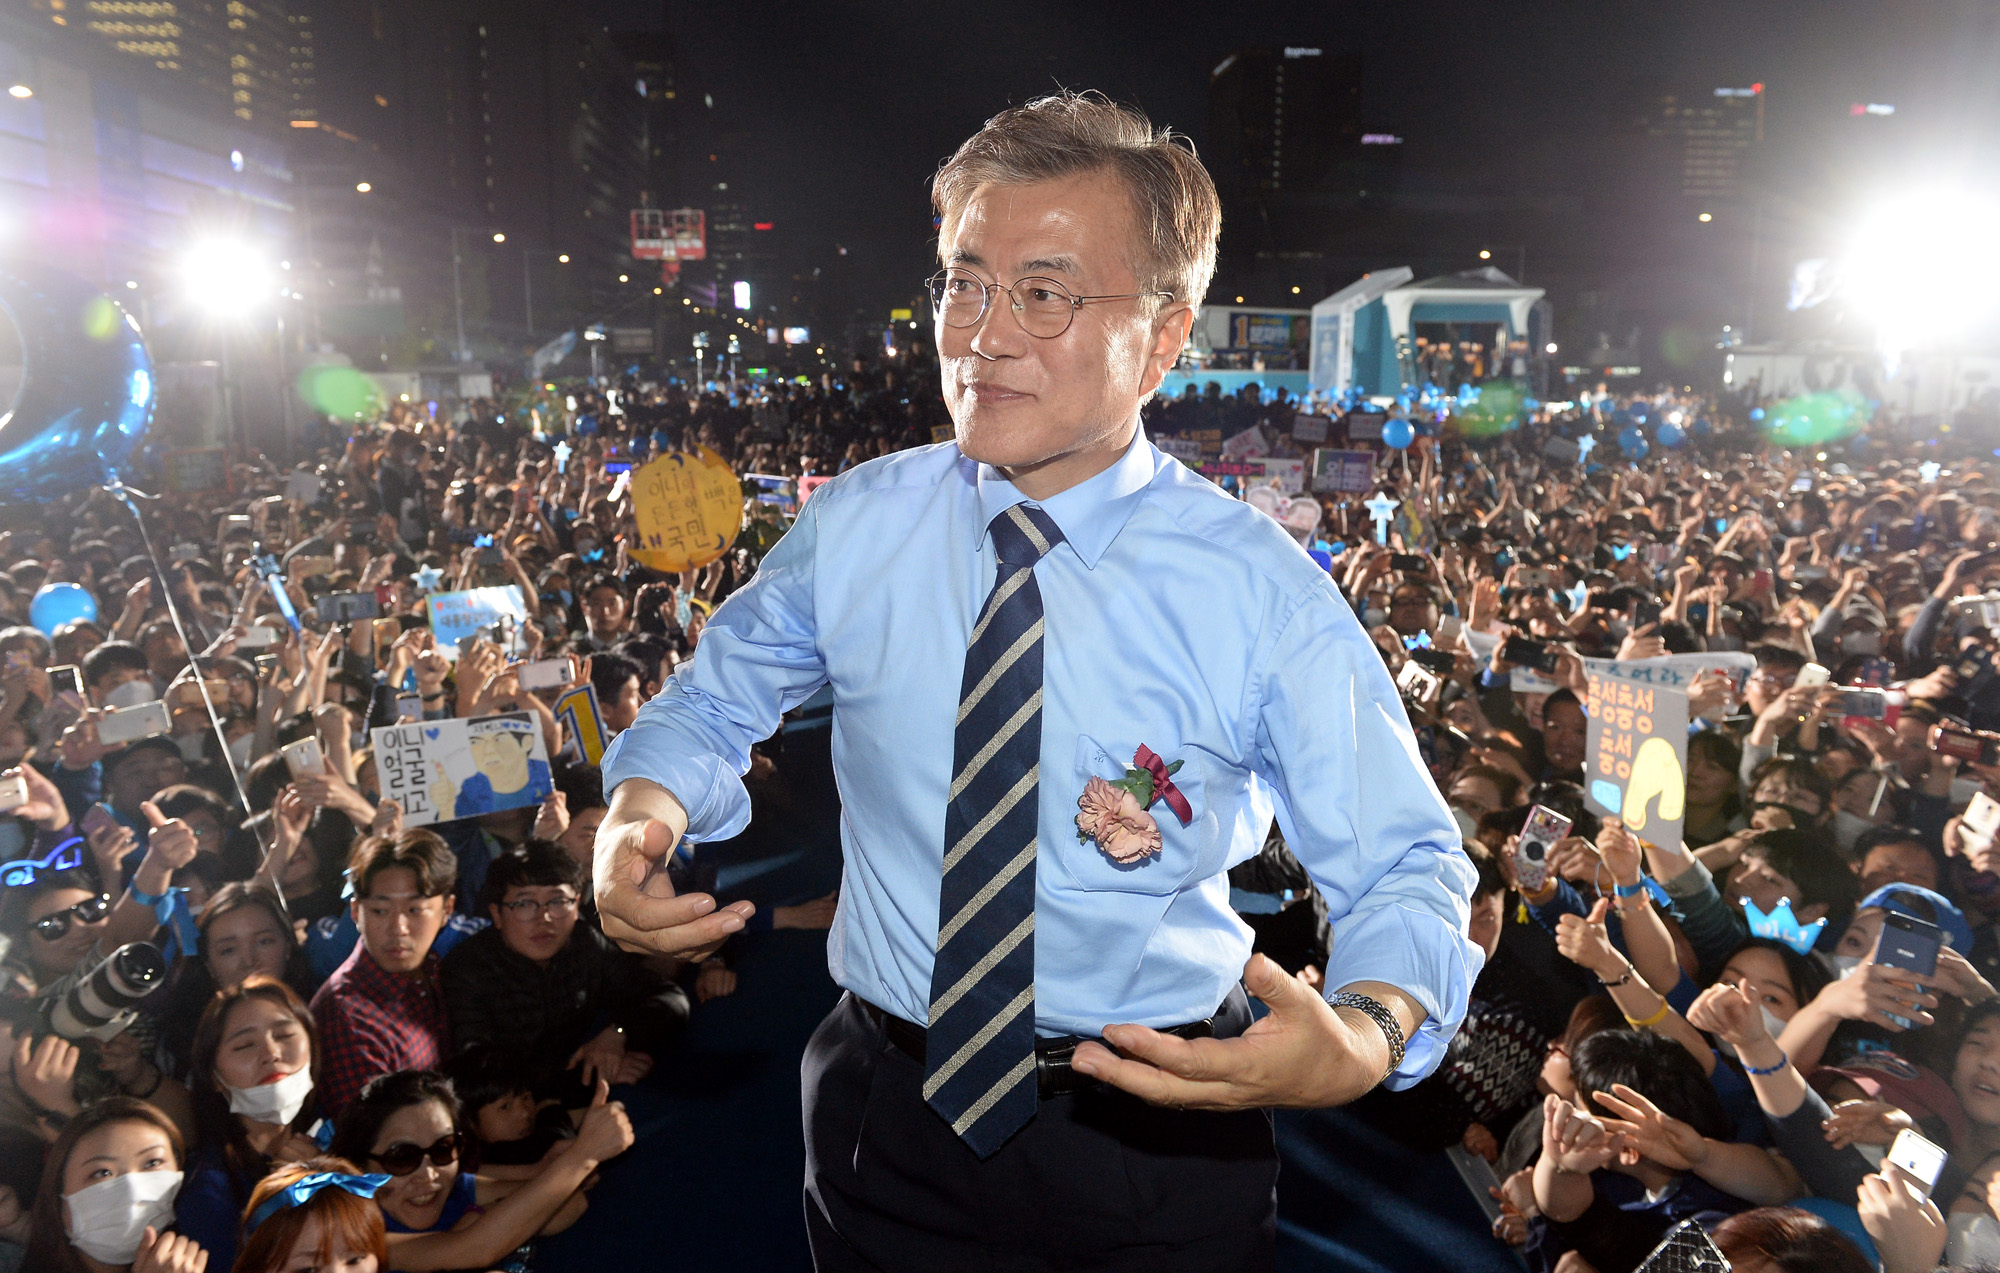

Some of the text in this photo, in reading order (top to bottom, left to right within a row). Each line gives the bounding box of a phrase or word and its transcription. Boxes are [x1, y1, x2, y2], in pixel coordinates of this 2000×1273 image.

[383, 726, 426, 749] 이니
[554, 686, 607, 767] 1
[384, 748, 427, 789] 얼굴
[1598, 728, 1633, 780] 충성
